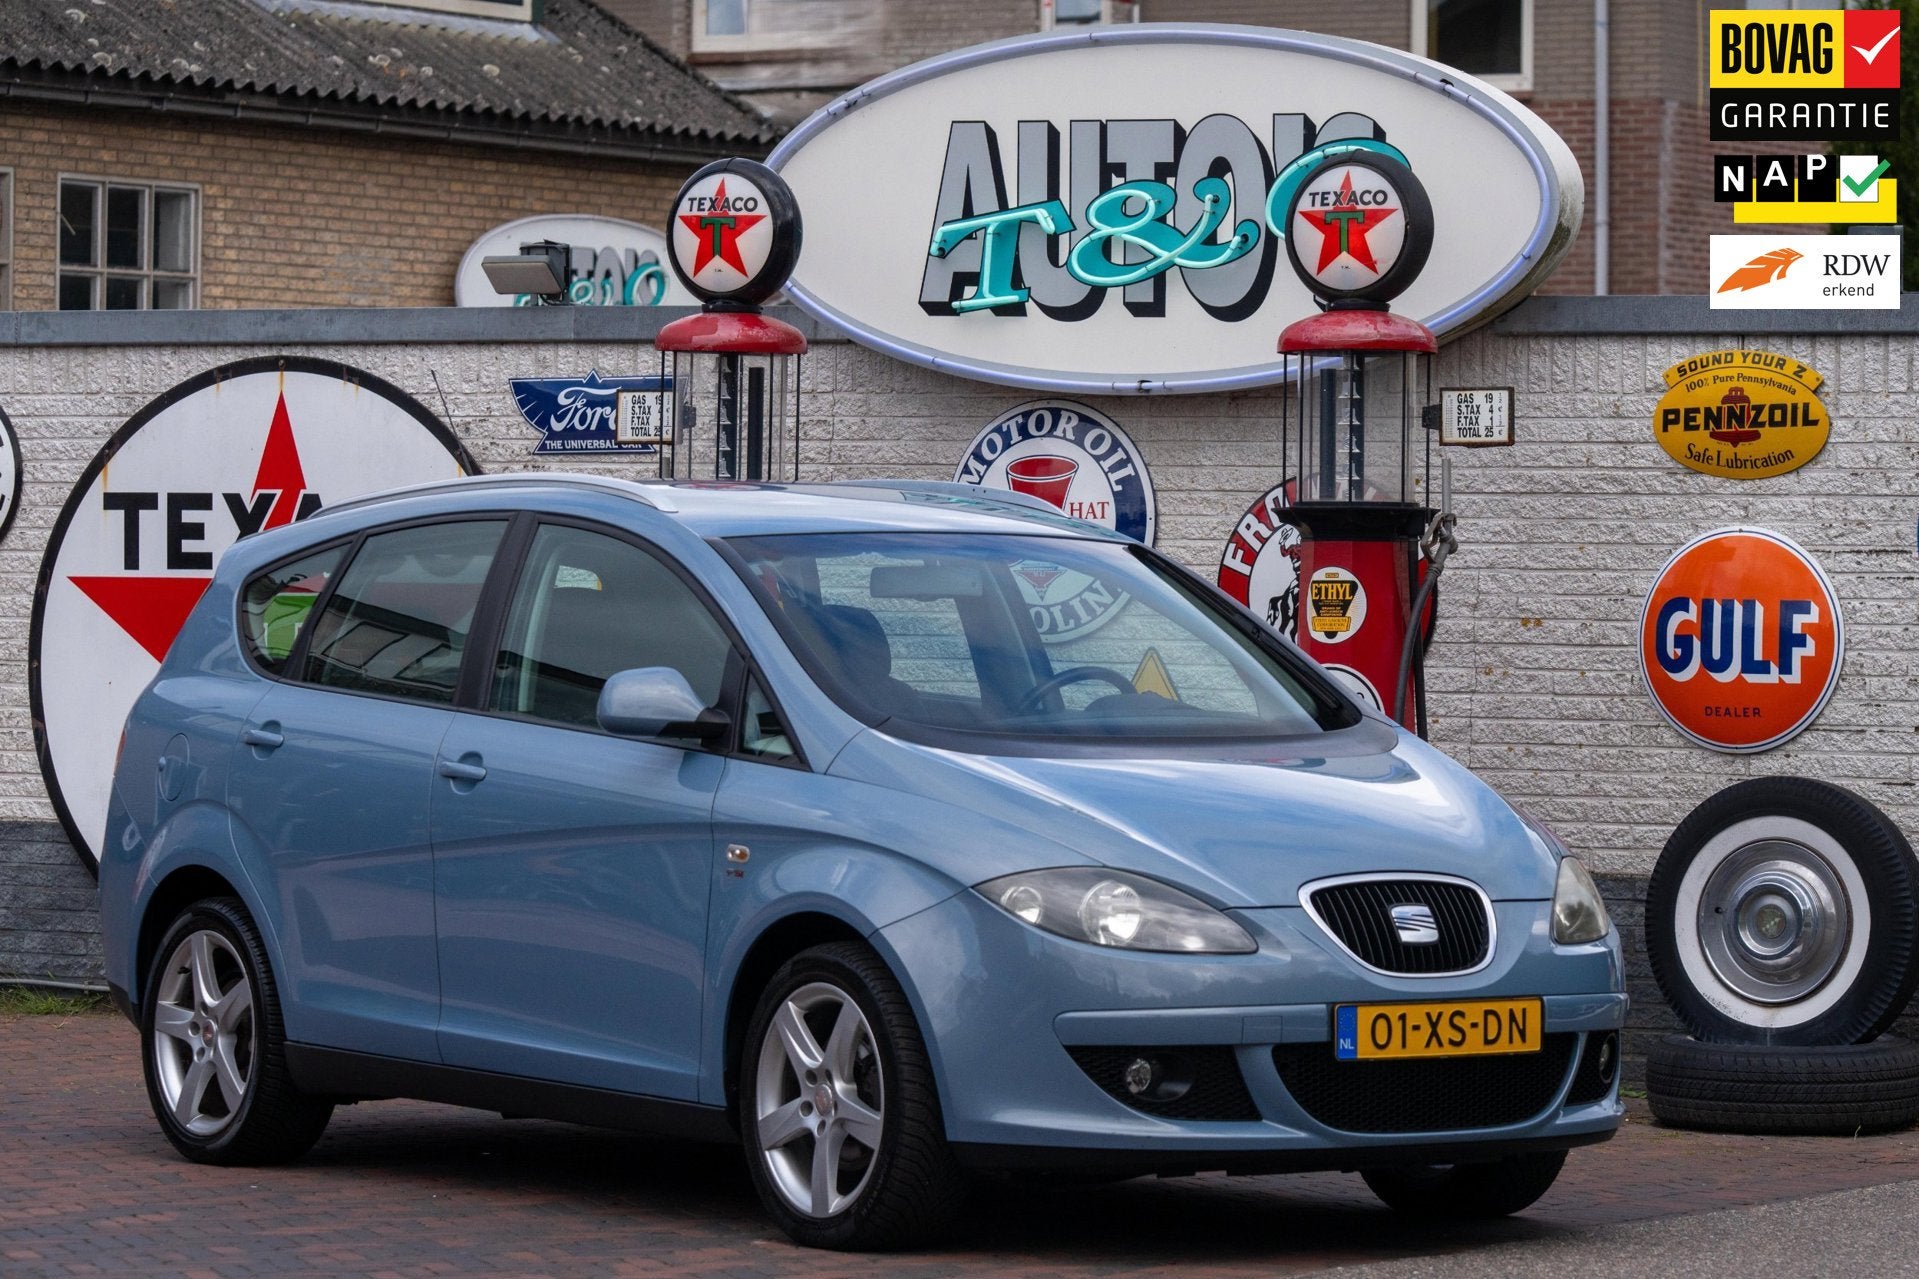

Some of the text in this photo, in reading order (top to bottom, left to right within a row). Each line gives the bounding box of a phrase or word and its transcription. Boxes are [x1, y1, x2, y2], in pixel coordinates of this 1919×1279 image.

[688, 197, 758, 212] TEXACO
[1309, 189, 1388, 207] TEXACO
[918, 111, 1387, 322] AUTO'
[1677, 352, 1808, 379] SOUND YOUR Z
[1685, 373, 1797, 396] 100% Pure Pennsylvania
[631, 395, 646, 405] GAS
[1457, 393, 1474, 404] GAS
[1484, 393, 1493, 404] 19
[631, 406, 652, 416] S.TAX
[1457, 404, 1481, 415] S.TAX
[1488, 404, 1494, 415] 4
[1662, 402, 1820, 433] PENNZOIL
[631, 416, 650, 426] F.TAX
[1457, 416, 1480, 427] F.TAX
[631, 427, 652, 437] TOTAL
[1457, 427, 1482, 438] TOTAL
[1484, 428, 1494, 438] 25
[545, 440, 563, 450] THE
[564, 440, 618, 449] UNIVERSAL
[961, 409, 1136, 492] MOTOR OIL
[1685, 443, 1795, 470] Safe Lubrication
[1068, 501, 1109, 520] HAT
[1312, 583, 1353, 600] ETHYL
[1030, 579, 1115, 633] OLIN
[1655, 596, 1819, 684] GULF
[1704, 706, 1761, 718] DEALER
[1370, 1007, 1527, 1050] 01-XS-DN
[1339, 1038, 1355, 1050] NL
